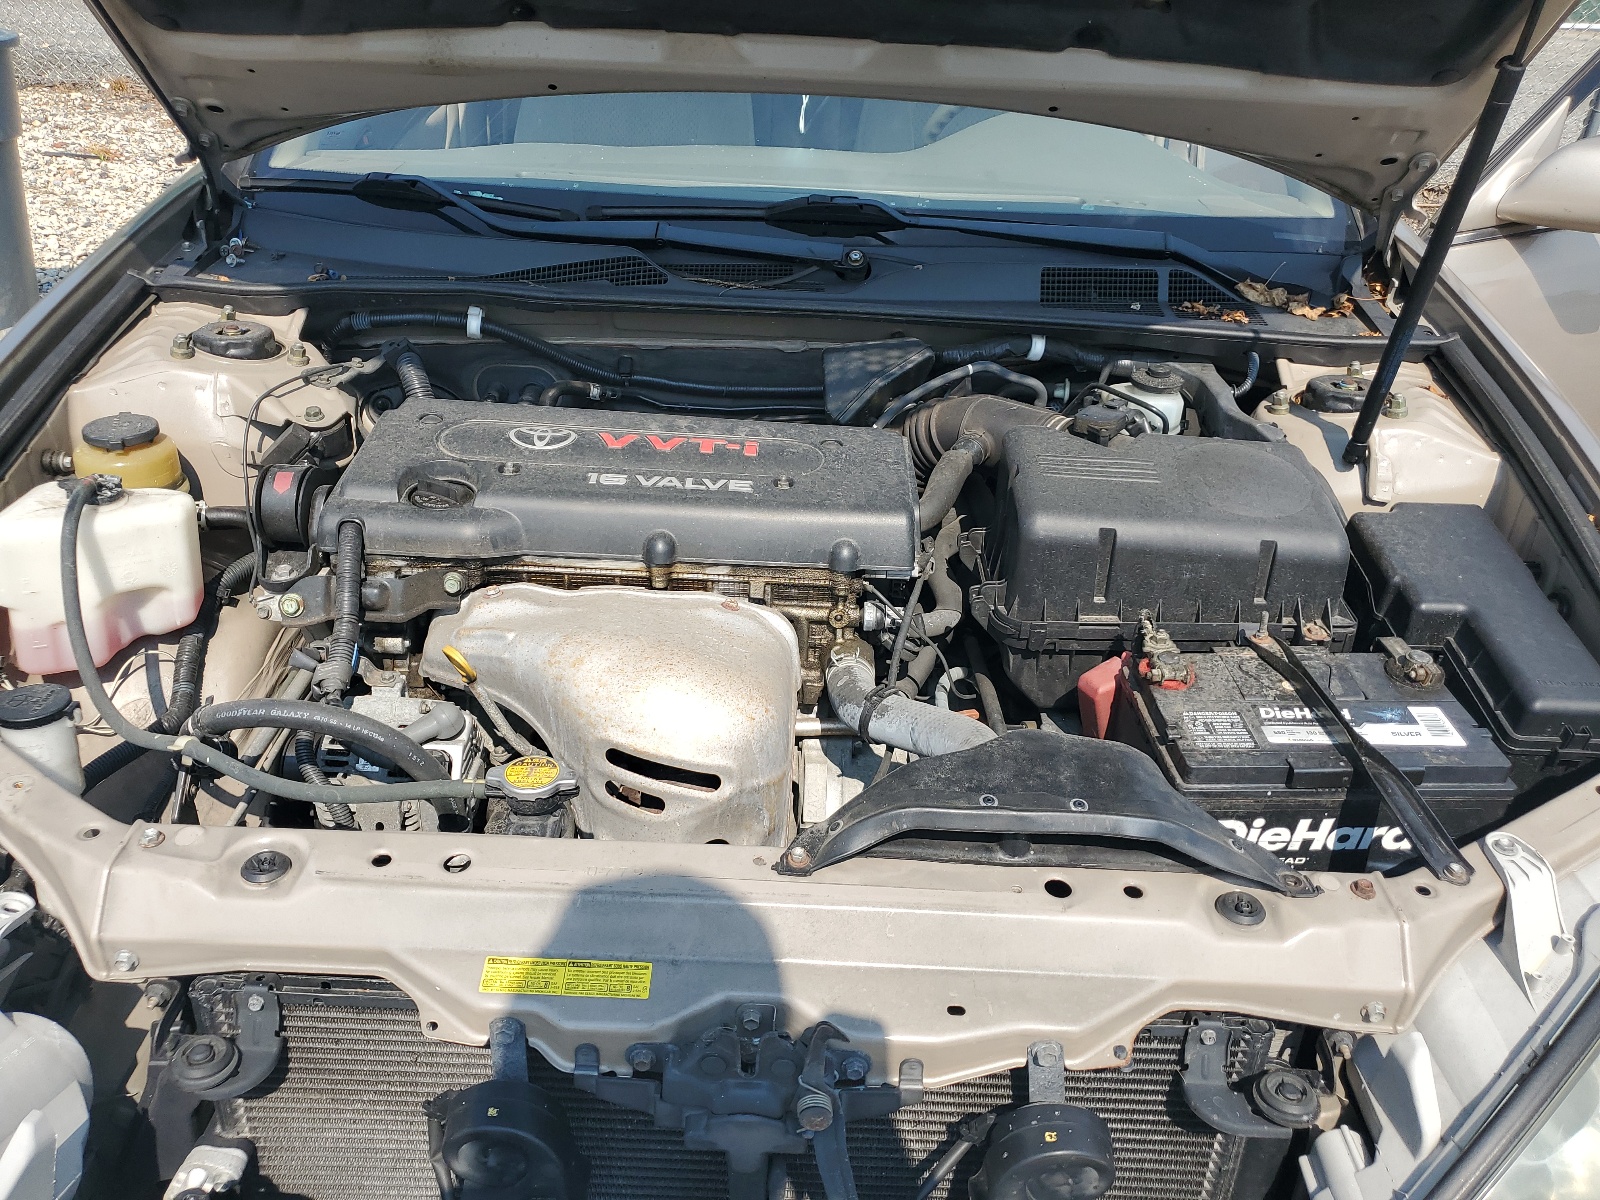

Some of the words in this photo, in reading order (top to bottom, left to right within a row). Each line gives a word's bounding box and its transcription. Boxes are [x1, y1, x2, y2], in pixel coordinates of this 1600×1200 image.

[597, 432, 760, 456] VVT-i
[588, 472, 629, 485] 16
[634, 474, 754, 493] VALVE
[216, 707, 266, 719] GOODYEAR
[270, 708, 310, 719] GALAXY
[1258, 707, 1351, 719] DieHd
